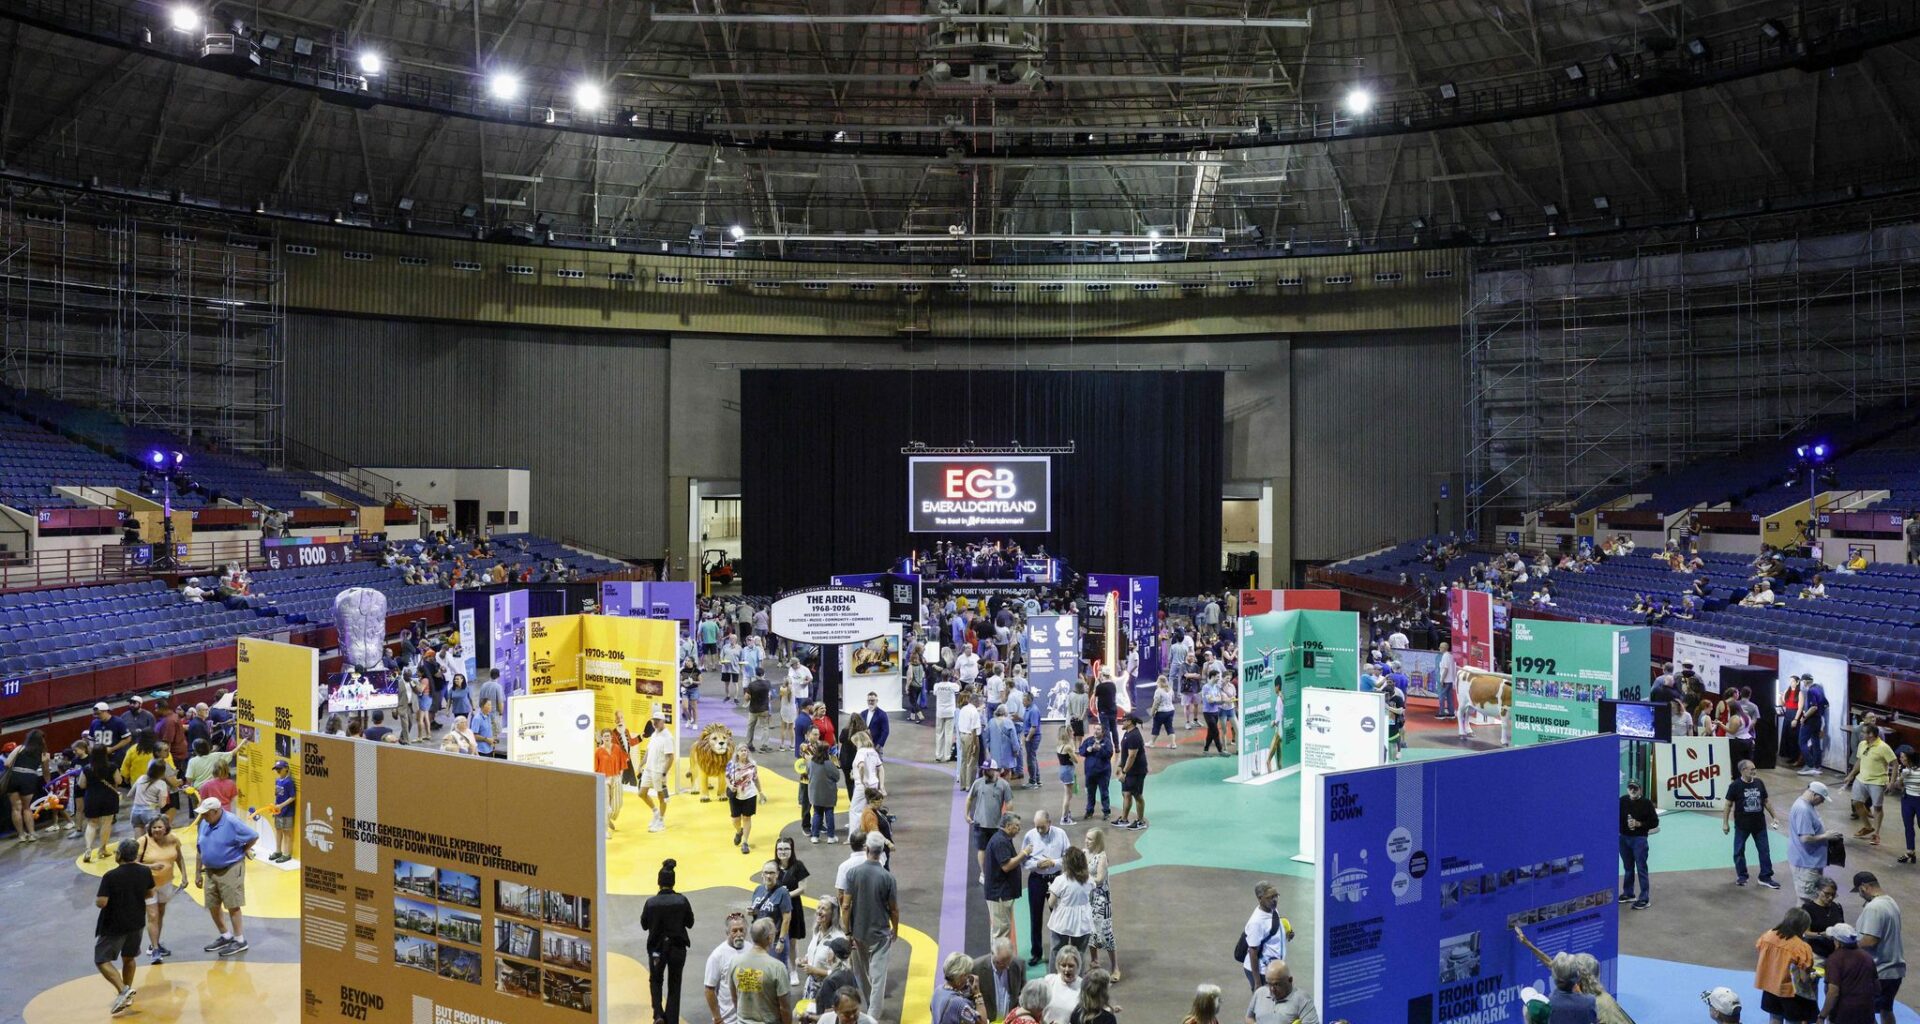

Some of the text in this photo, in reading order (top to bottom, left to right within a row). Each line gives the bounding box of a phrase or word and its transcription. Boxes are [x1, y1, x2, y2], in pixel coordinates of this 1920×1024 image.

[946, 469, 1017, 499] ECB
[922, 501, 1037, 513] EMERALDCITYBAND
[39, 512, 50, 521] 317
[139, 547, 149, 557] 211
[177, 546, 187, 555] 212
[299, 547, 327, 566] FOOD
[806, 595, 856, 604] THE ARENA
[1303, 641, 1324, 650] 1996
[584, 648, 625, 660] 1970s-2016
[1515, 656, 1556, 676] 1992
[532, 676, 552, 686] 1978
[584, 674, 632, 686] UNDER THE DOME
[4, 680, 20, 695] 111
[1620, 685, 1640, 700] 1968
[238, 698, 255, 710] 1968-
[238, 708, 255, 722] 1990s
[274, 706, 293, 719] 1988-
[275, 717, 291, 730] 2009
[1515, 714, 1570, 728] THE DAVIS CUP
[1515, 722, 1530, 731] USA
[1531, 724, 1544, 732] VS.
[304, 742, 318, 754] IT'S
[304, 754, 326, 766] GOIN'
[304, 764, 328, 778] DOWN
[1667, 764, 1720, 797] ARENA
[1330, 783, 1349, 796] IT'S
[1330, 794, 1359, 810] GOIN'
[1330, 806, 1363, 822] DOWN
[342, 816, 502, 858] THE NEXT GENERATION WILL EXPERIENCE
[342, 828, 538, 876] THIS CORNER OF DOWNTOWN VERY DIFFERENTLY
[1439, 974, 1503, 1005] FROM CITY
[340, 985, 384, 1010] BEYOND
[1439, 984, 1524, 1022] BLOCK TO CITY
[340, 1001, 367, 1021] 2027
[436, 1004, 452, 1019] BUT
